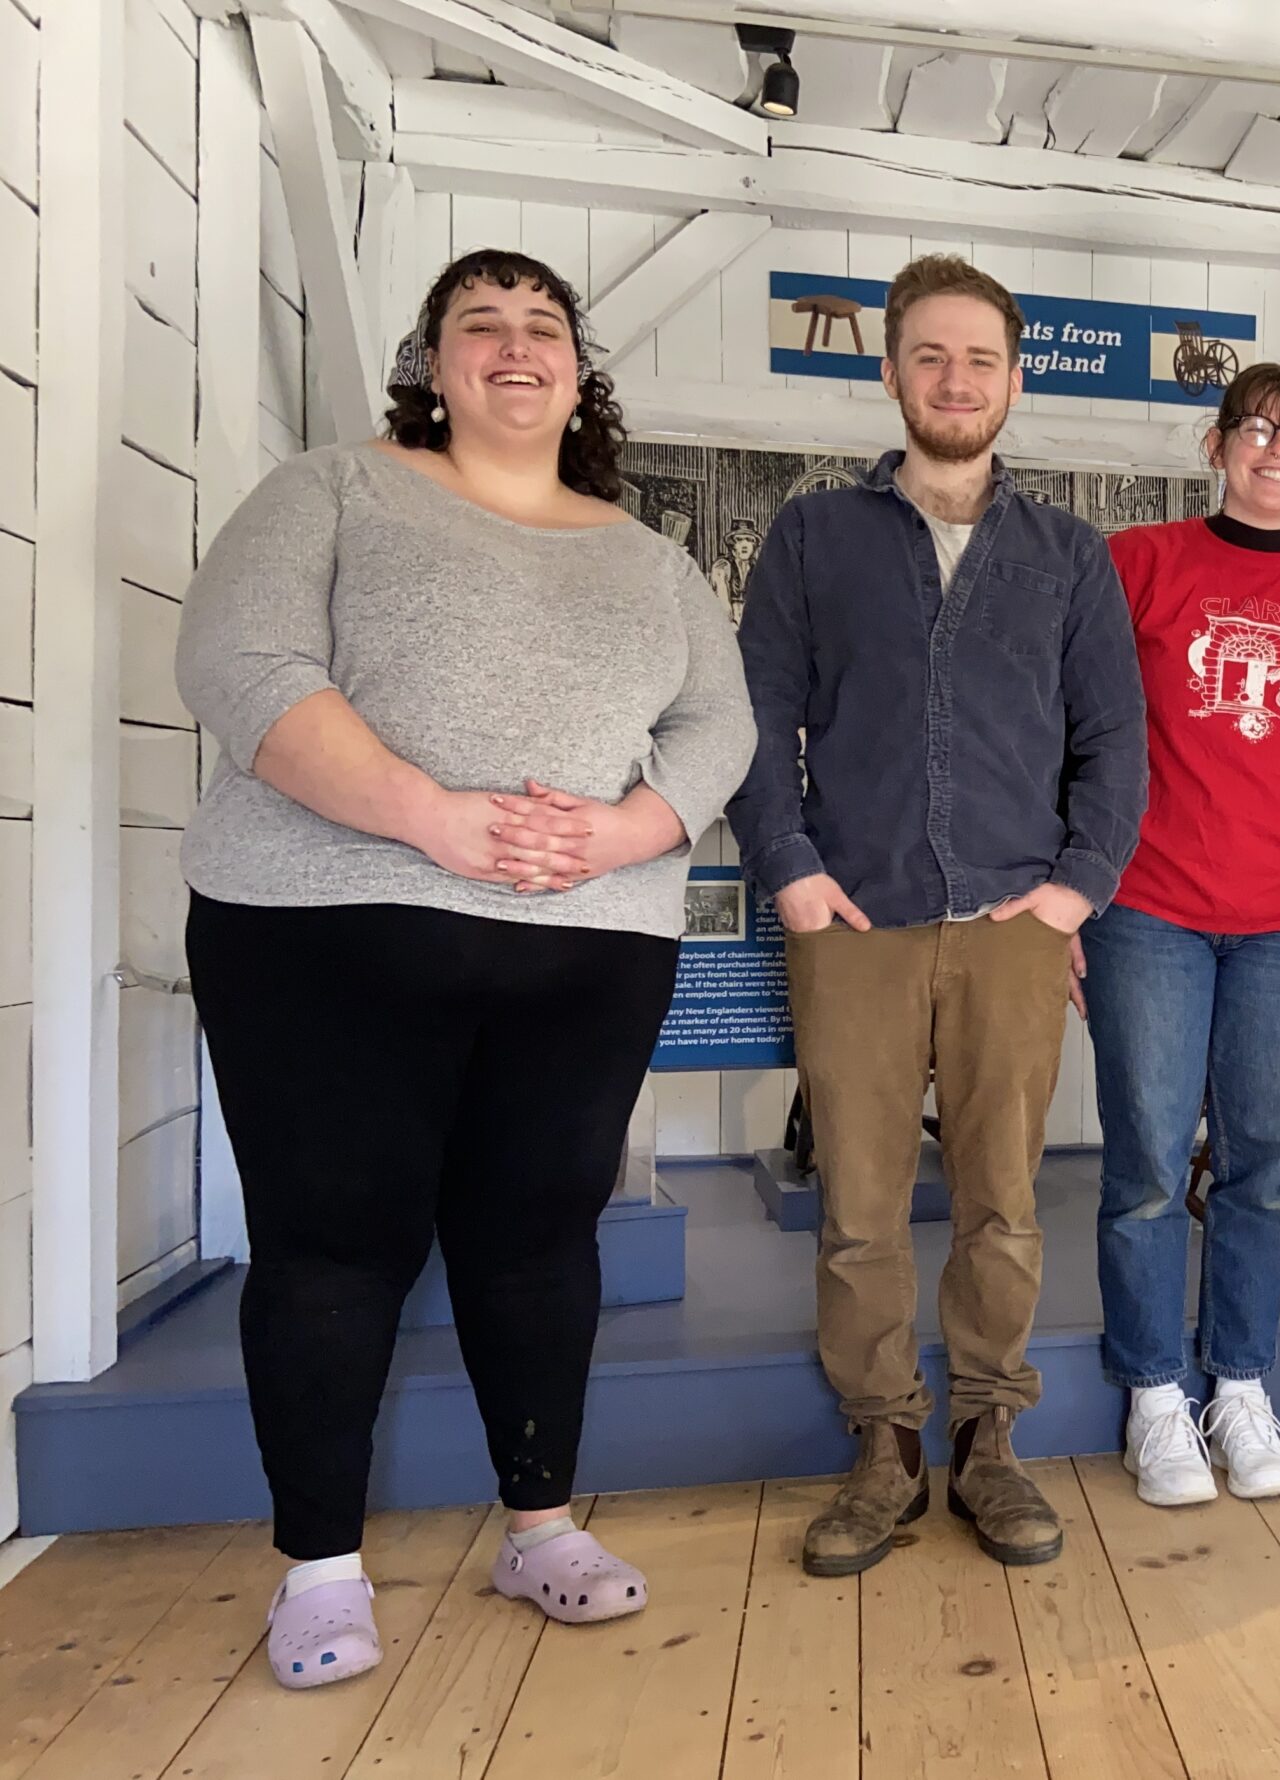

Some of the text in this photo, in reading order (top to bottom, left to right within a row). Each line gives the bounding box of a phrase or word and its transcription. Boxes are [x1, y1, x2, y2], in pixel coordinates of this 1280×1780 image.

[1020, 321, 1122, 347] ats from
[1019, 350, 1107, 375] ngland
[766, 934, 786, 942] mak
[678, 952, 716, 962] daybook
[728, 951, 774, 959] chairmaker
[692, 961, 716, 969] often
[716, 960, 760, 970] purchased
[684, 971, 706, 980] parts
[729, 970, 749, 978] local
[750, 970, 788, 978] woodturn
[695, 980, 702, 988] If
[703, 980, 718, 988] the
[718, 980, 744, 988] chairs
[685, 990, 728, 1000] employed
[668, 1008, 683, 1016] any
[706, 1006, 754, 1016] Englanders
[720, 1016, 769, 1024] refinement.
[770, 1016, 780, 1024] By
[660, 1028, 680, 1036] have
[693, 1028, 717, 1036] many
[730, 1026, 740, 1034] 20
[742, 1026, 766, 1034] chairs
[660, 1035, 784, 1048] you have in your home today?
